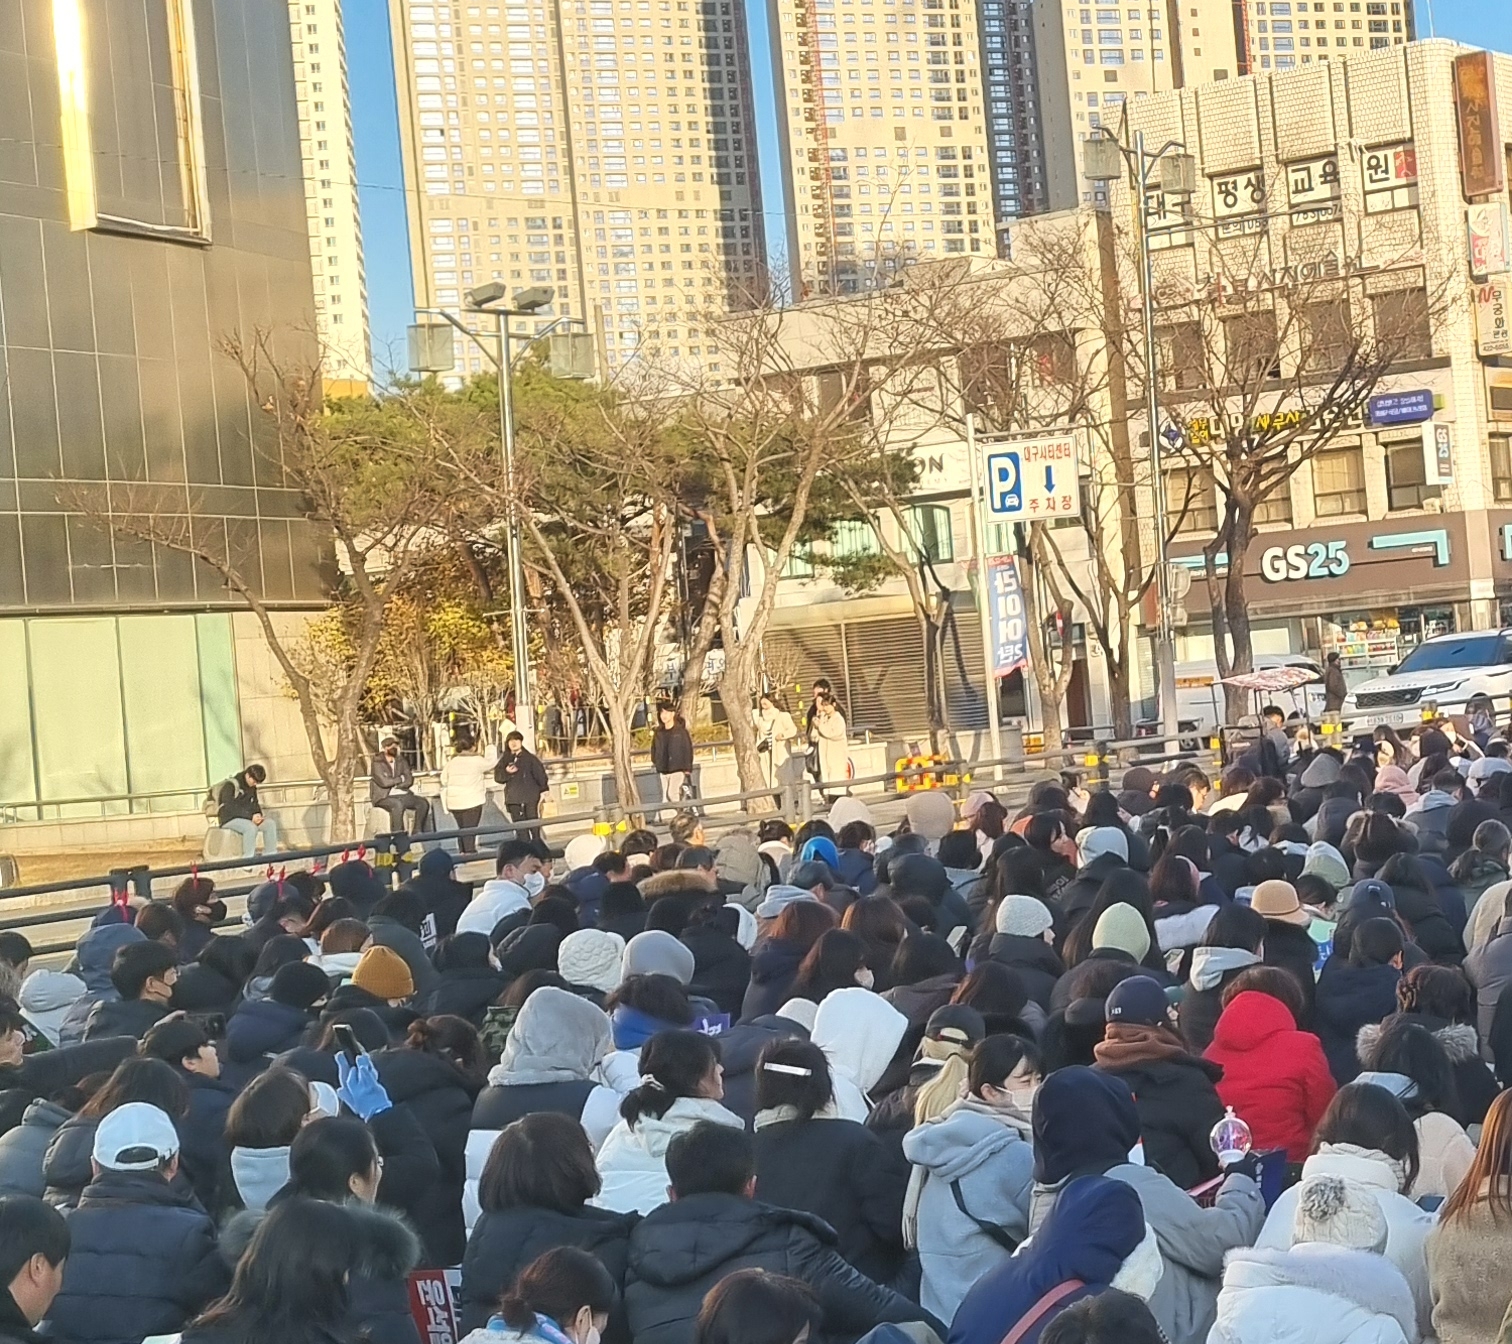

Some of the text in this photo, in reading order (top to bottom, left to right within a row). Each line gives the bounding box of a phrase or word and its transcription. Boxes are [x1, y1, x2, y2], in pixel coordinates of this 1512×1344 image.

[1217, 171, 1266, 209] 평생
[1290, 159, 1340, 197] 교육
[1367, 153, 1390, 184] 원
[1491, 290, 1505, 329] 무궁화
[1436, 427, 1449, 444] GS
[1437, 443, 1450, 458] 25
[1261, 540, 1350, 582] GS25
